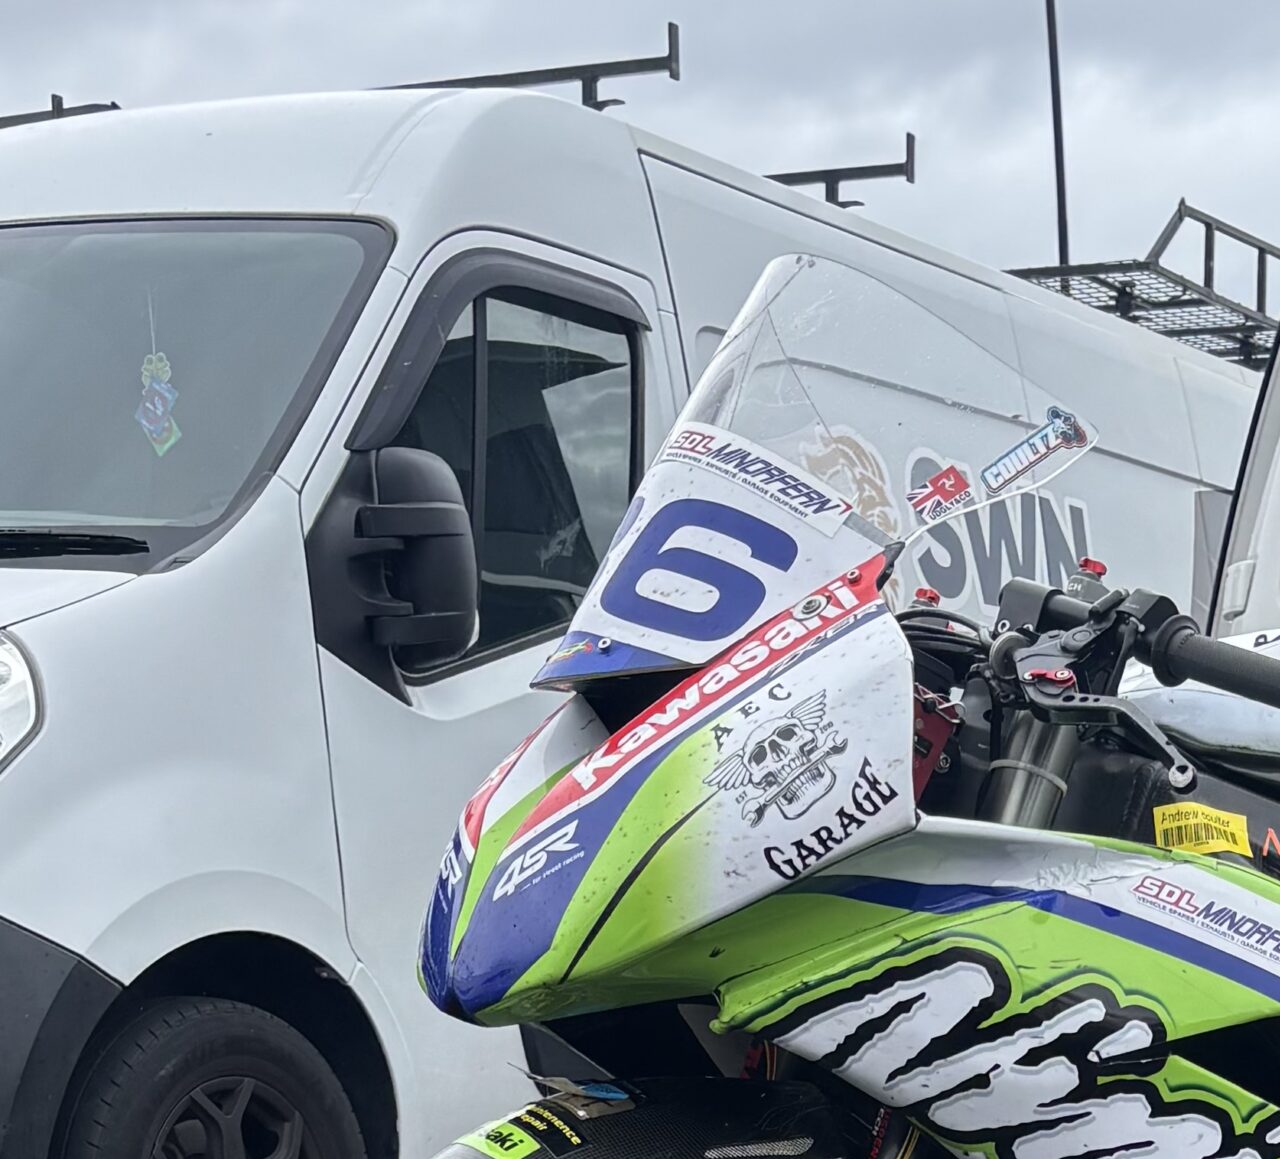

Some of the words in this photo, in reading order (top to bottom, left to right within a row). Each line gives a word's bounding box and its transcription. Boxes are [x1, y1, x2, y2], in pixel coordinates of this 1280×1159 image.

[668, 430, 716, 456] SDL
[983, 424, 1063, 488] COULTZ
[588, 496, 799, 642] 6
[911, 456, 1089, 606] SWN
[764, 756, 899, 881] GARAGE
[1132, 876, 1200, 915] SDL
